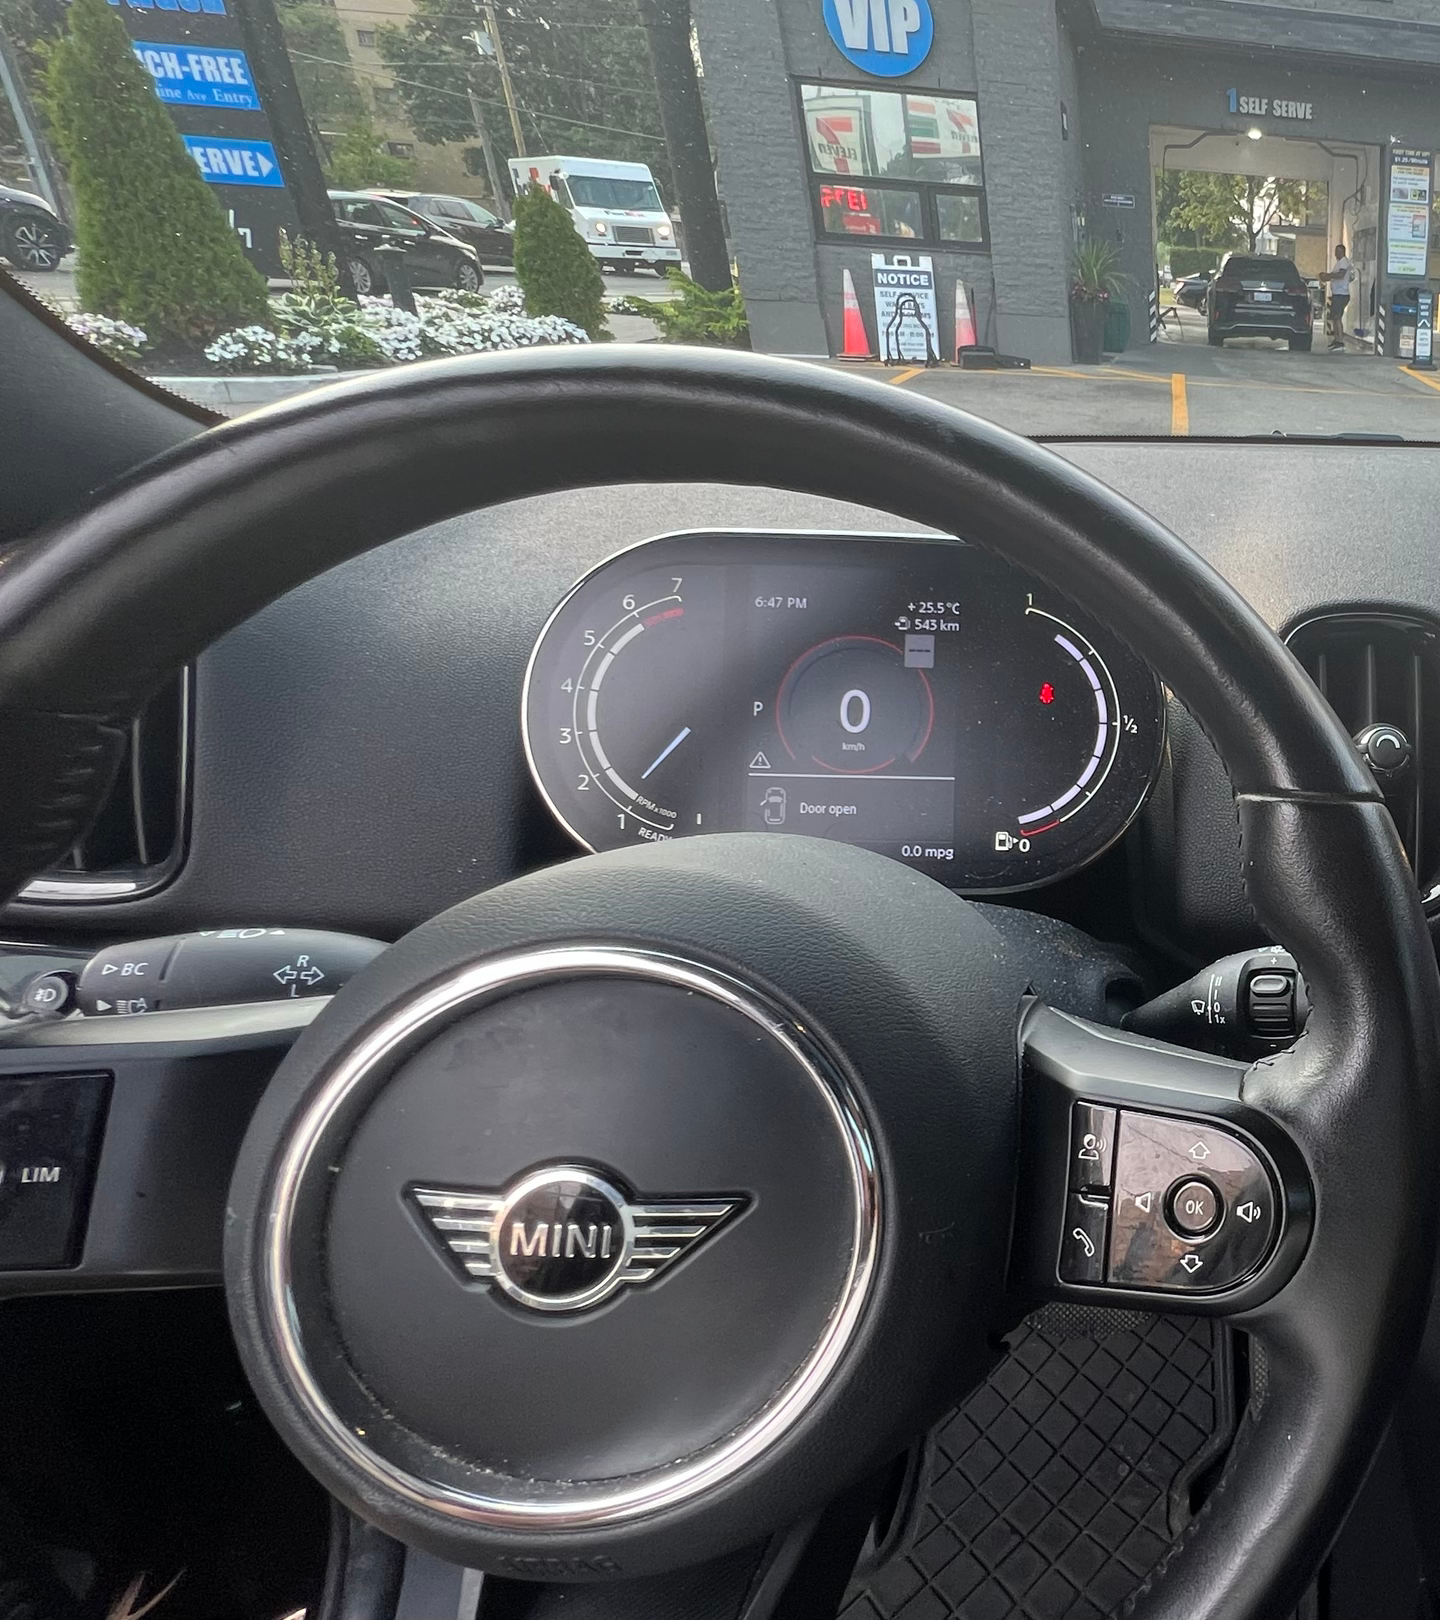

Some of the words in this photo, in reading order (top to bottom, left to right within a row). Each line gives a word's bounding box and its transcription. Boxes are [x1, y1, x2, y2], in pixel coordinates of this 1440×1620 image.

[833, 0, 921, 54] VIP
[134, 49, 249, 86] CH-FREE
[213, 89, 252, 108] Entry
[1226, 88, 1237, 113] 1
[1239, 96, 1268, 114] SELF
[1272, 100, 1313, 119] SERVE
[189, 146, 259, 177] ERVE
[877, 273, 929, 286] NOTICE
[670, 577, 683, 592] 7
[622, 594, 635, 610] 6
[755, 597, 783, 608] 6:47
[787, 597, 808, 609] PM
[1026, 593, 1033, 605] 1
[914, 619, 937, 631] 543
[940, 619, 960, 631] km
[583, 630, 596, 646] 5
[560, 678, 573, 693] 4
[753, 701, 763, 716] P
[840, 689, 871, 733] 0
[559, 728, 571, 744] 3
[842, 742, 865, 752] km/h
[577, 775, 589, 790] 2
[636, 795, 656, 810] RPM
[653, 808, 677, 819] x1000
[800, 802, 826, 814] Door
[829, 804, 857, 817] open
[616, 813, 625, 829] 1
[901, 845, 922, 857] 0.0
[925, 847, 954, 860] mpg
[1018, 838, 1030, 852] 0
[297, 955, 309, 967] R
[121, 963, 148, 976] BC
[290, 984, 299, 997] L
[1213, 1002, 1220, 1013] 0
[1214, 1014, 1226, 1024] 1x
[21, 1166, 61, 1183] LIM
[1185, 1200, 1204, 1215] OK
[510, 1222, 612, 1258] MINI
